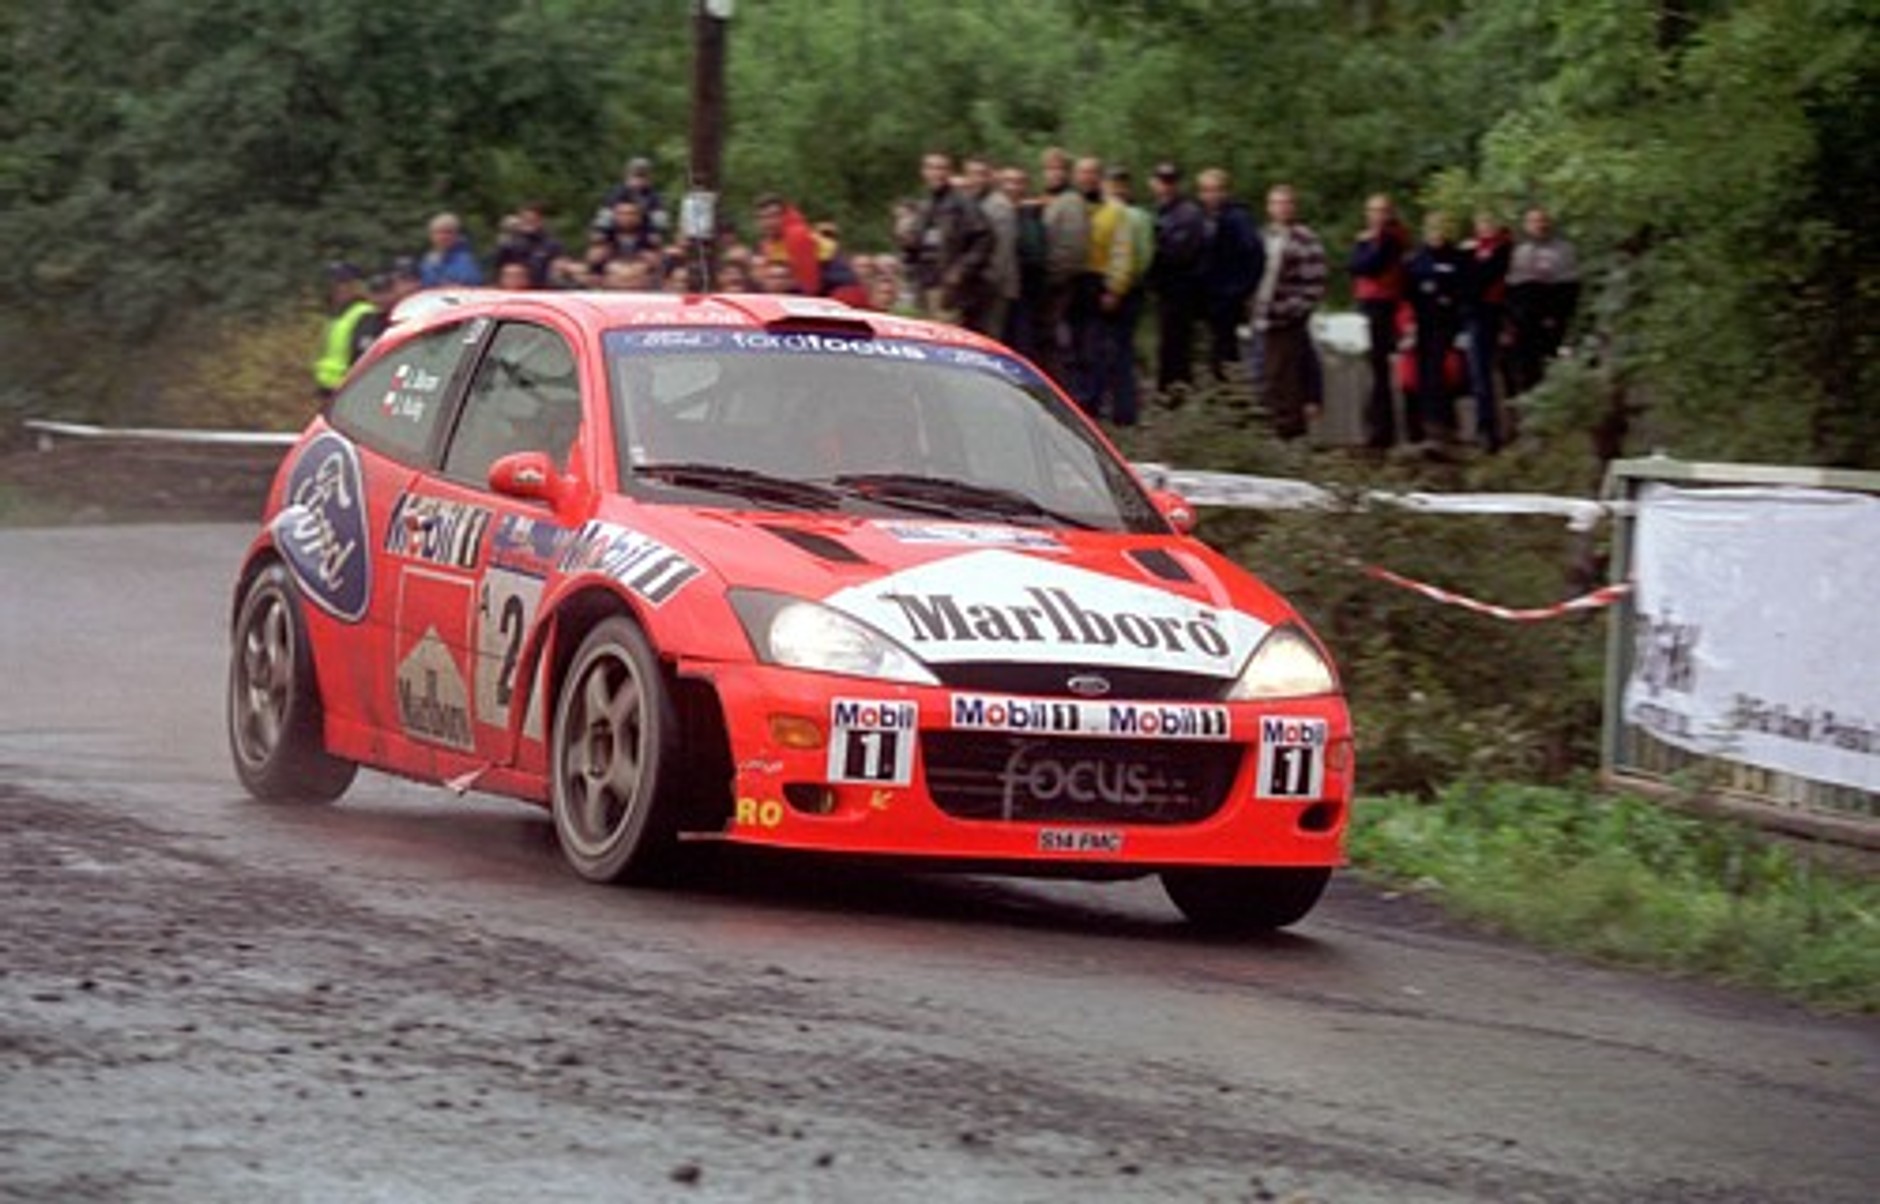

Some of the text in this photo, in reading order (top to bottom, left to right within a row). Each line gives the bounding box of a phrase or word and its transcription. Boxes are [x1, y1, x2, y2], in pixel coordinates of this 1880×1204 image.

[293, 451, 356, 592] Ford
[877, 587, 1229, 658] Marlboro
[497, 594, 525, 706] 2
[834, 703, 914, 728] Mobil
[953, 699, 1047, 729] Mobil
[1108, 706, 1196, 735] Mobil
[1264, 720, 1324, 745] Mobil
[860, 732, 881, 777] 1
[1283, 748, 1301, 793] 1
